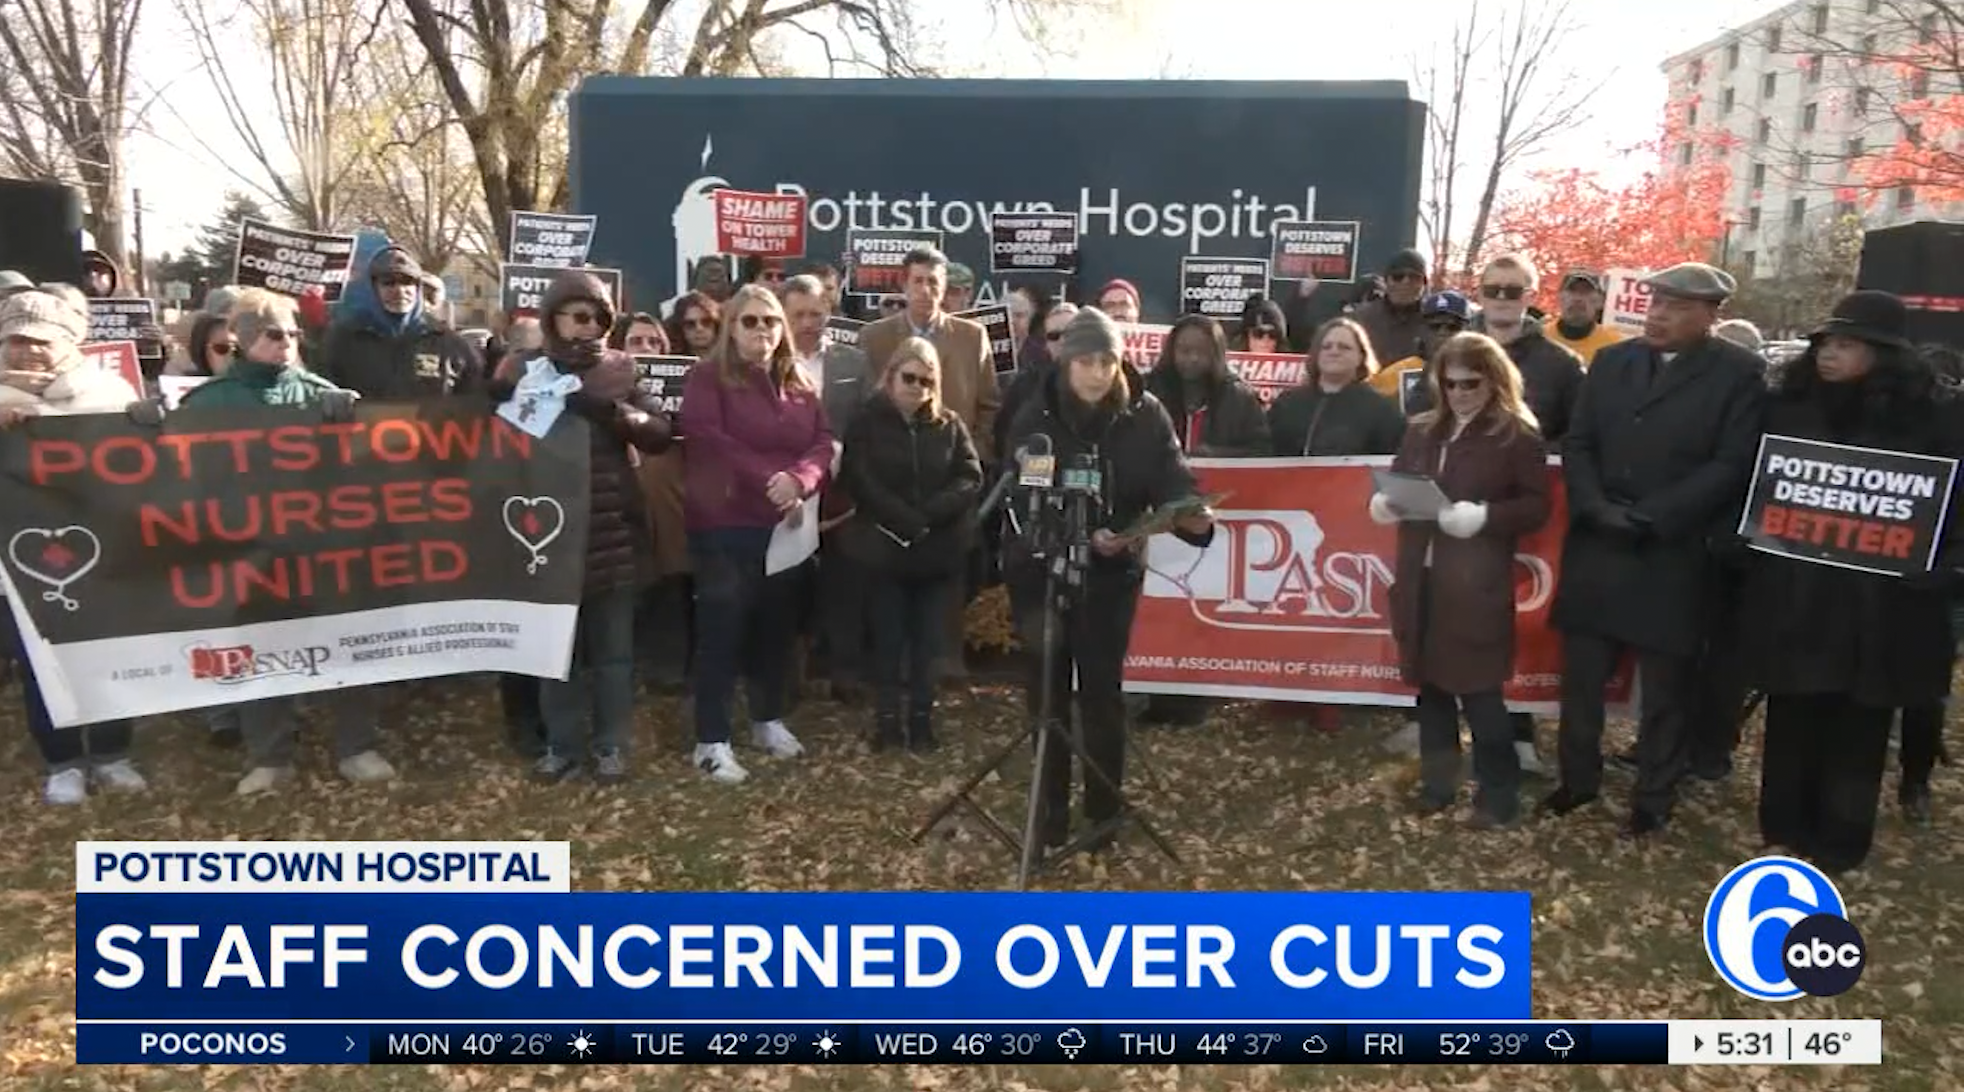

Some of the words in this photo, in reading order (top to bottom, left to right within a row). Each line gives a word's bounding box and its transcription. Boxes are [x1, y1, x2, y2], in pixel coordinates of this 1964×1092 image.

[721, 198, 798, 219] SHAME
[721, 220, 743, 235] ON
[745, 224, 798, 237] TOWER
[1015, 230, 1052, 241] OVER
[1280, 229, 1352, 243] POTTSTOWN
[538, 232, 574, 244] OVER
[731, 236, 786, 252] HEALTH
[995, 242, 1074, 255] CORPORATE
[1285, 242, 1345, 255] DESERVES
[275, 247, 326, 268] OVER
[1012, 254, 1057, 265] GREED
[1205, 274, 1242, 287] OVER
[1200, 300, 1245, 313] GREED
[29, 417, 532, 485] POTTSTOWN
[1767, 454, 1937, 498] POTTSTOWN
[1774, 480, 1915, 521] DESERVES
[140, 478, 473, 548] NURSES
[1764, 504, 1914, 559] BETTER
[171, 541, 468, 608] UNITED
[338, 628, 419, 648] PENNSYLVANIA
[420, 622, 484, 637] ASSOCIATION
[352, 646, 395, 662] NURSES
[1178, 658, 1281, 674] ASSOCIATION
[1284, 662, 1307, 674] OF
[1310, 665, 1360, 678] STAFF
